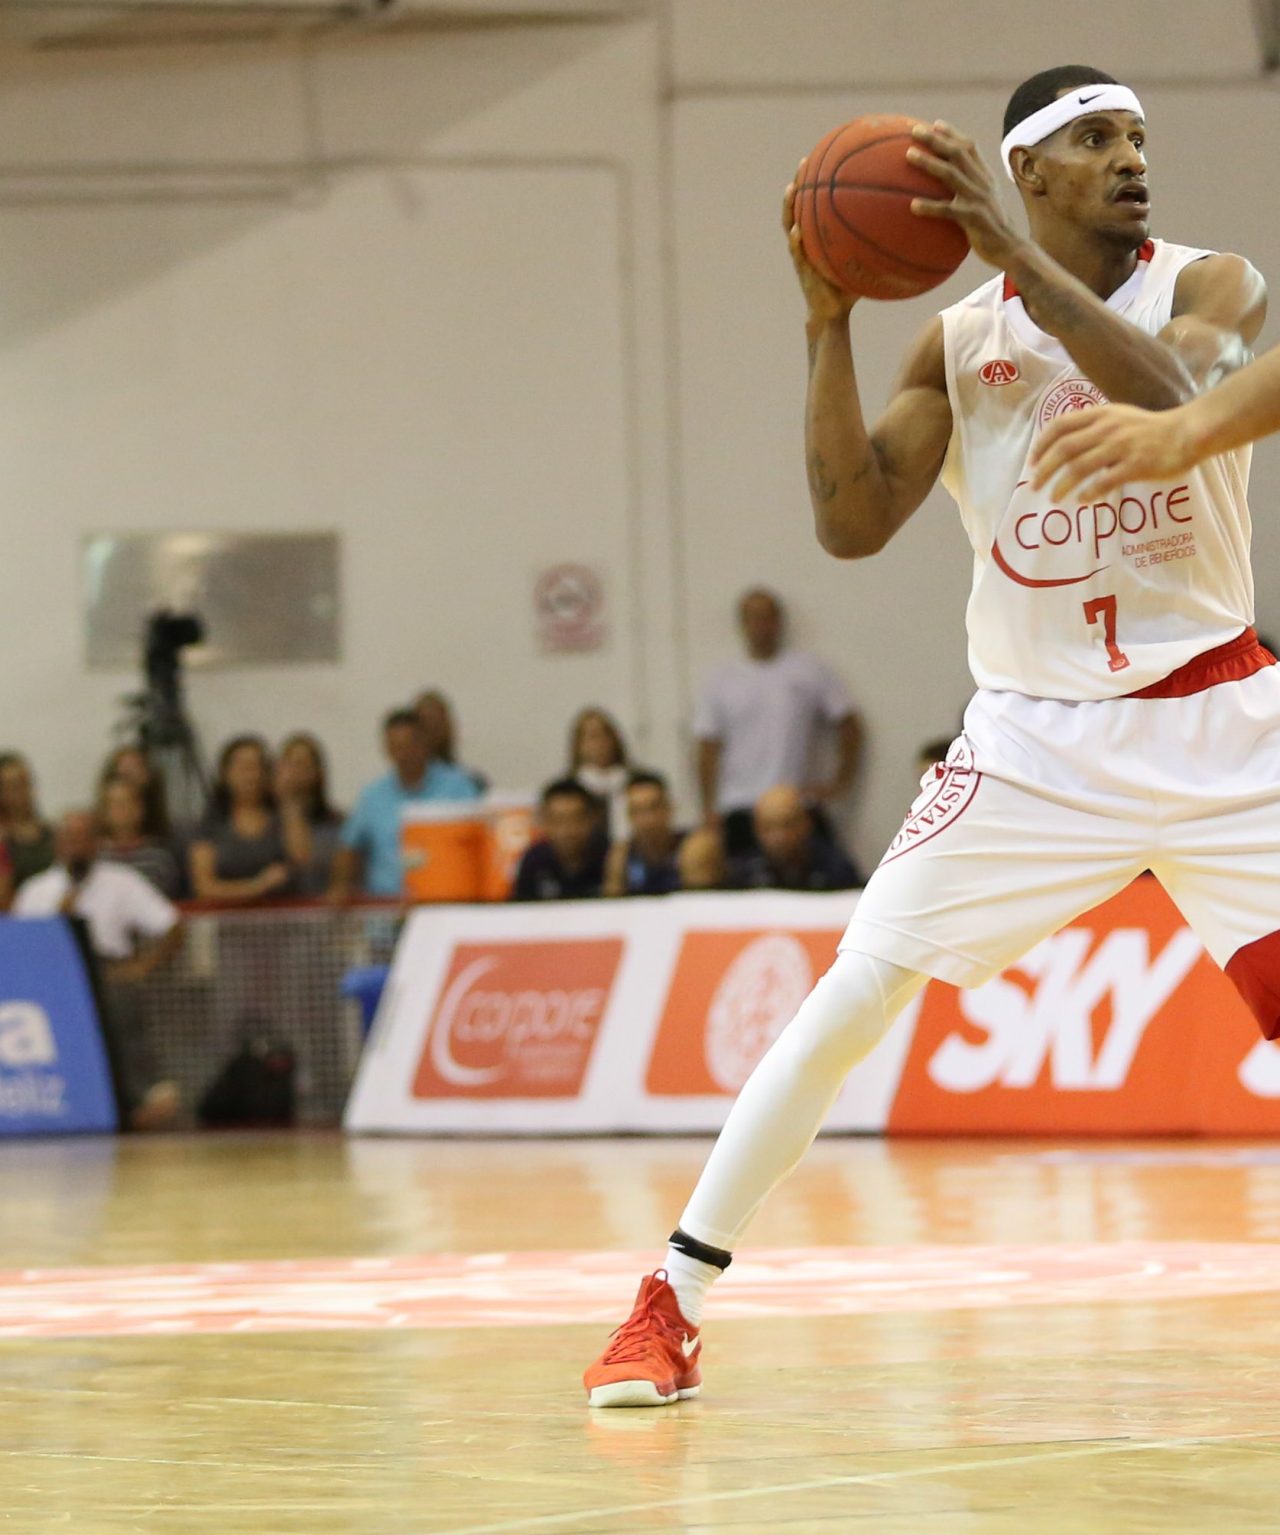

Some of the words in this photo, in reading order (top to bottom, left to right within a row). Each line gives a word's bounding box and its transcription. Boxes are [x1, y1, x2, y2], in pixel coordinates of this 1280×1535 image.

[1014, 485, 1193, 559] corpore
[1082, 594, 1131, 673] 7
[926, 926, 1203, 1092] SKY
